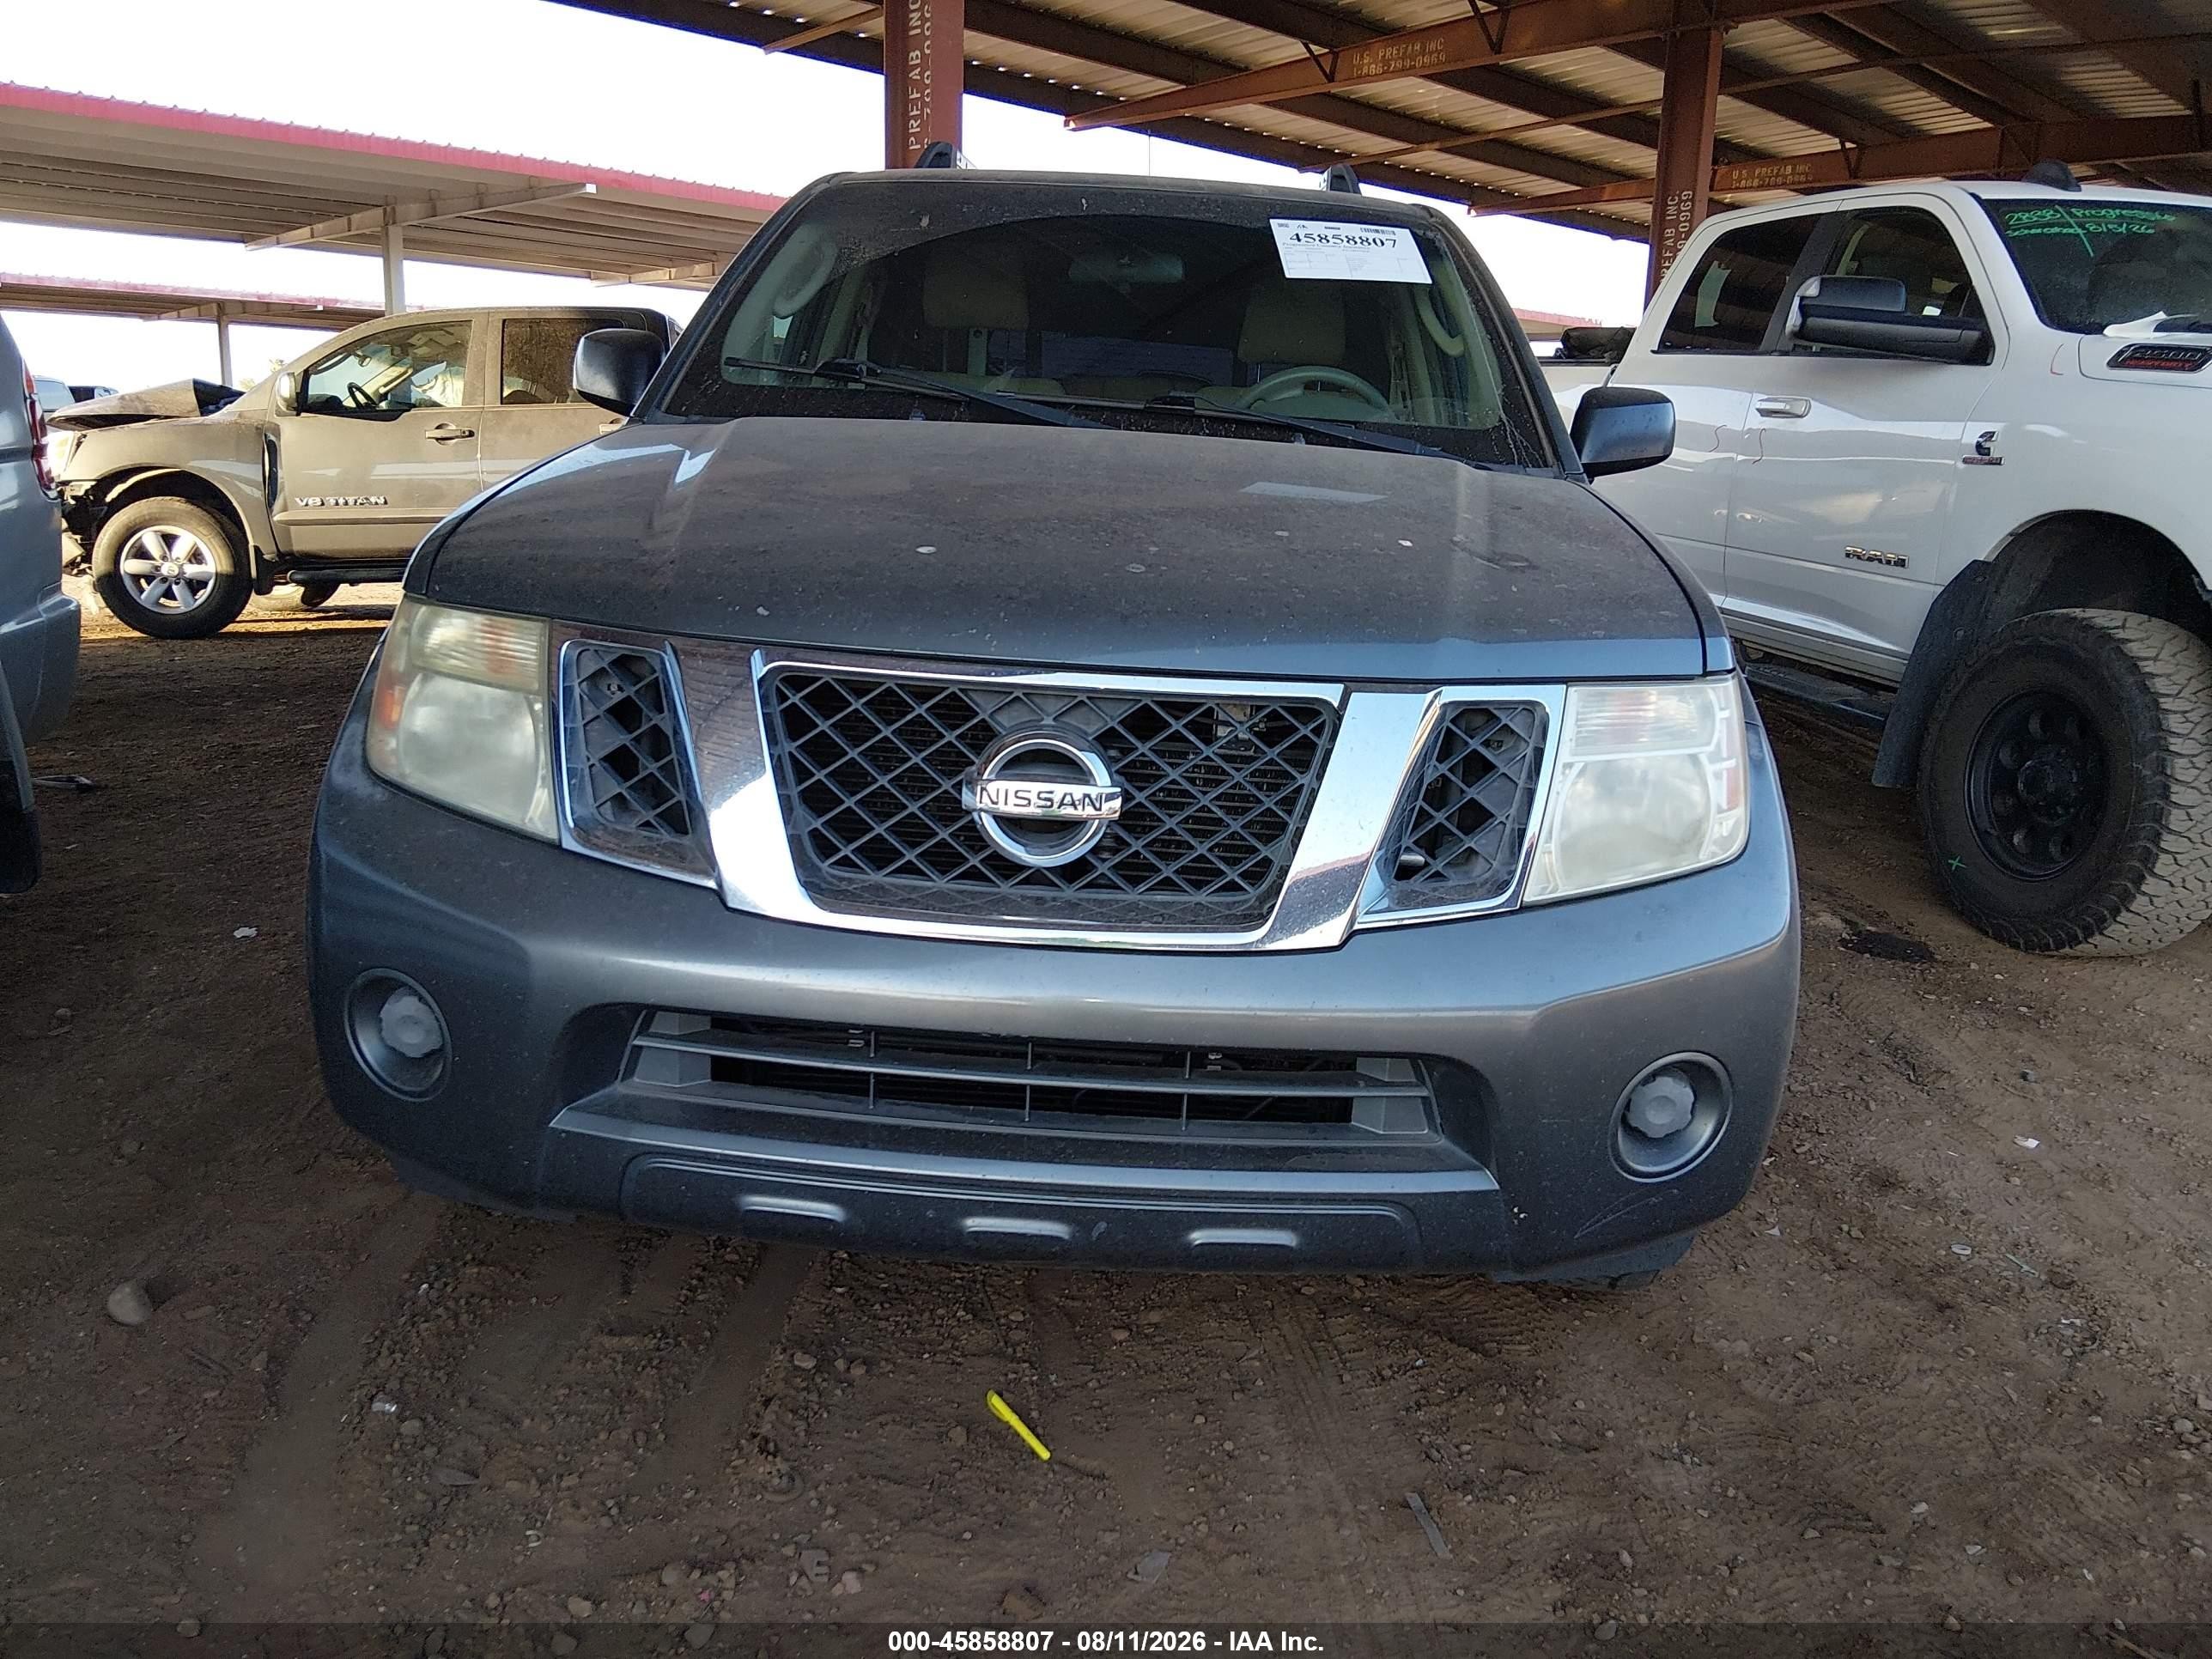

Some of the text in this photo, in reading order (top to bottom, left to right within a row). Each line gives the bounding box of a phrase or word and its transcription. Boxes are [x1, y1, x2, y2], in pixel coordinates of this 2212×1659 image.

[908, 48, 921, 150] PREFAB
[1290, 232, 1398, 249] 45858807
[1660, 228, 1676, 283] REFAB
[295, 495, 389, 507] V8 TITAN
[1844, 544, 1910, 568] RAM
[979, 784, 1103, 812] NISSAN
